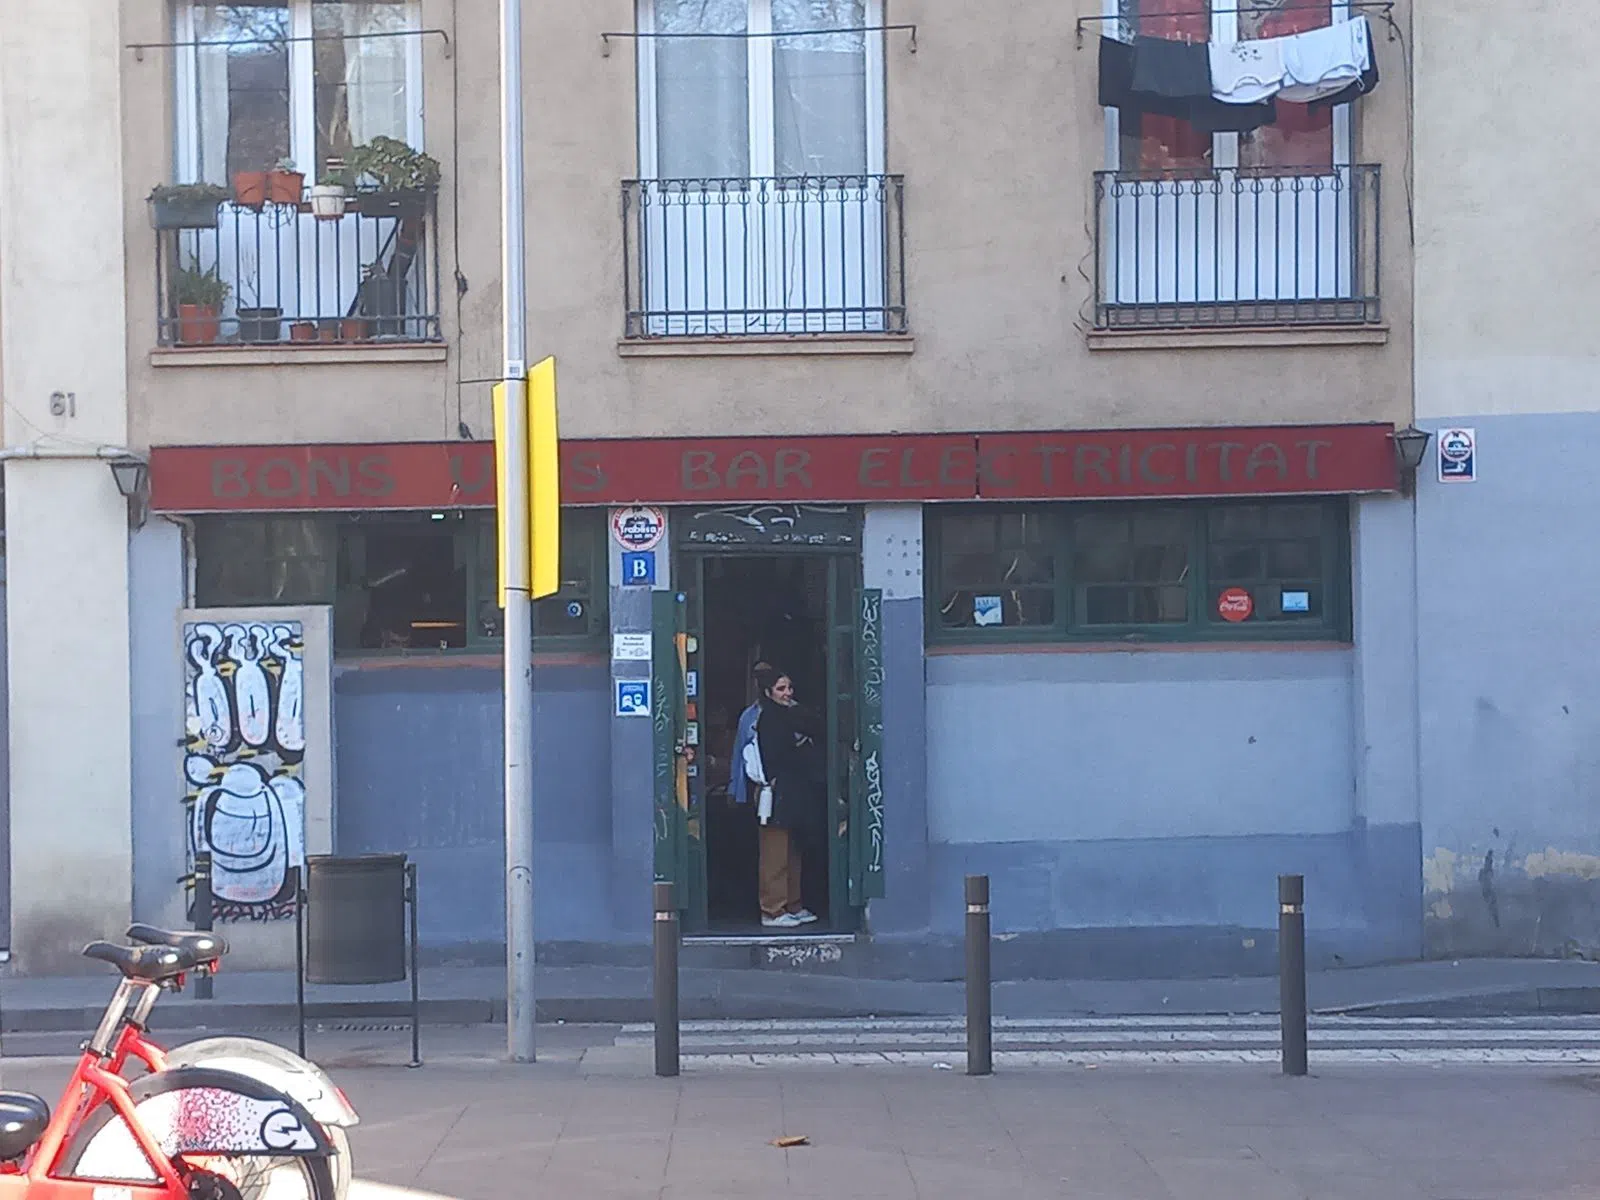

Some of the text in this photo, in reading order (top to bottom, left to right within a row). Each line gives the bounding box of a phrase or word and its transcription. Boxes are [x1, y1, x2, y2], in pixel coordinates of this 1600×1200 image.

[50, 392, 76, 418] 61
[209, 454, 396, 498] BONS
[680, 447, 813, 491] BAR
[857, 438, 1332, 490] ELECTRICITAT
[632, 559, 648, 577] B
